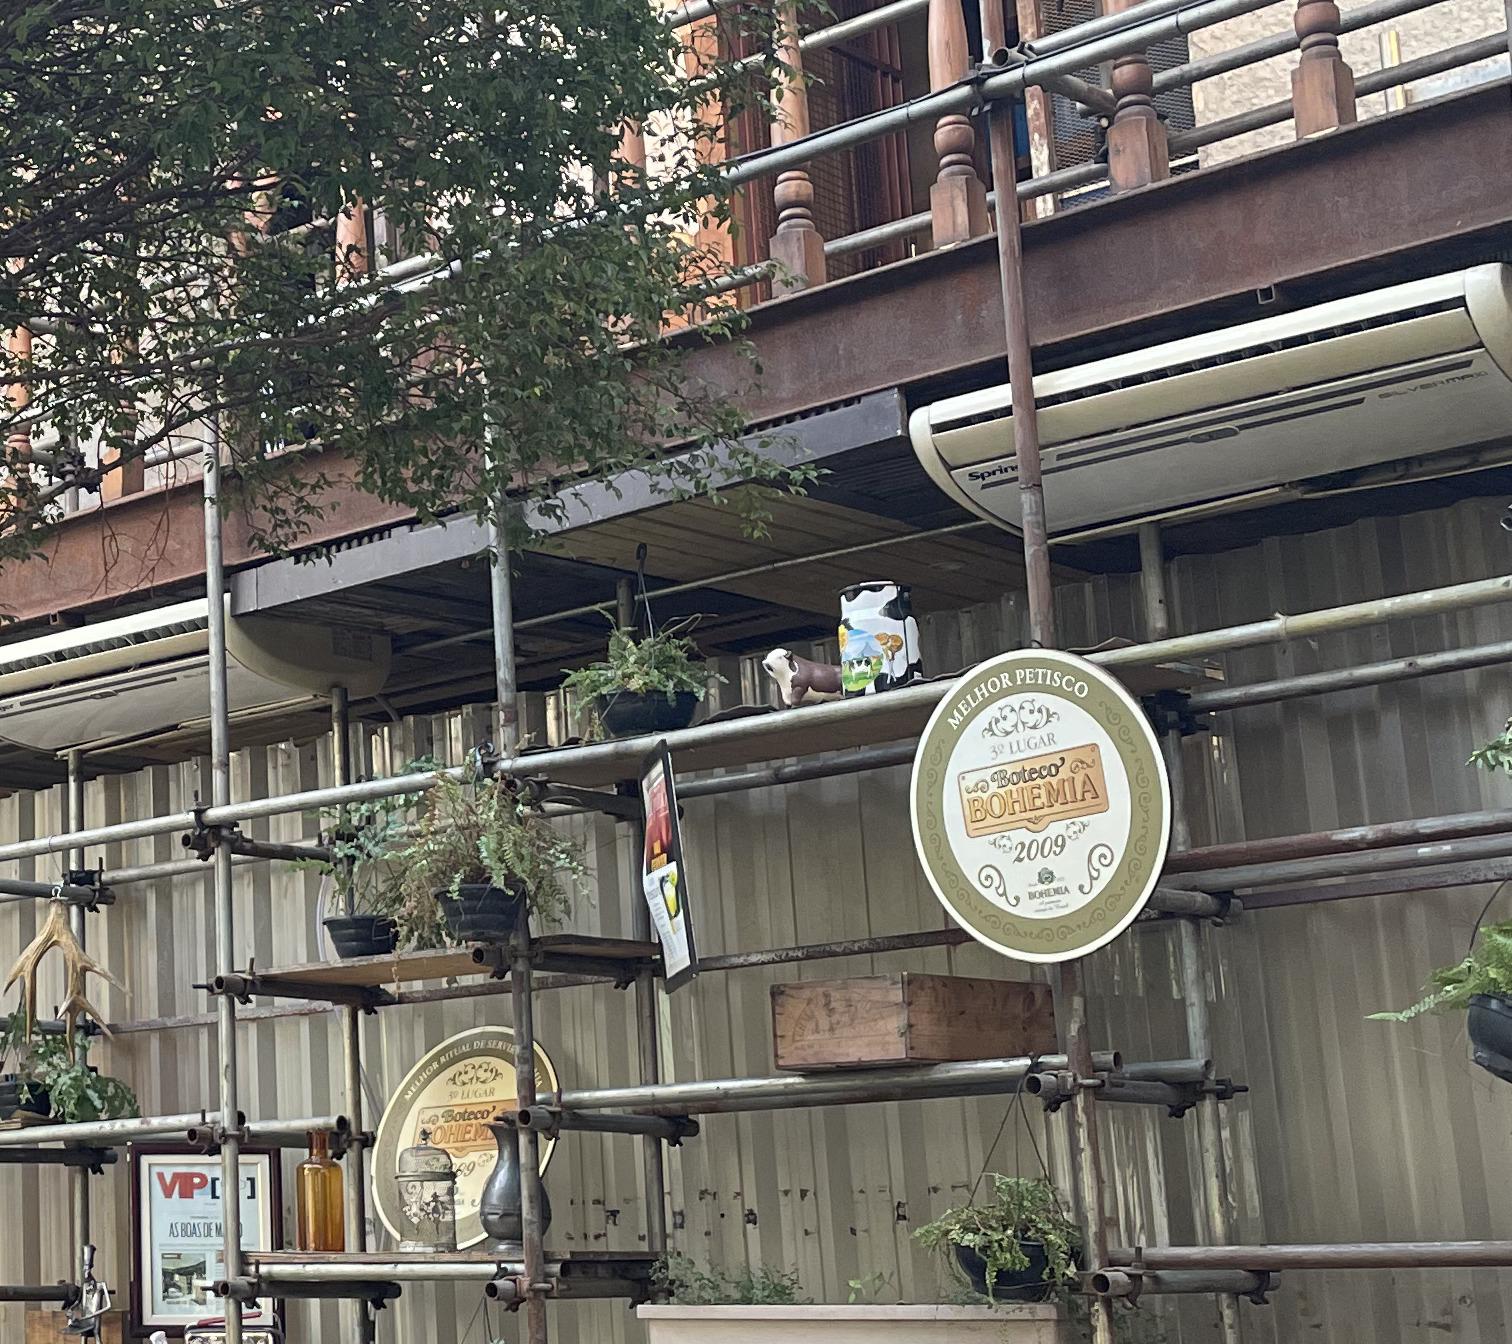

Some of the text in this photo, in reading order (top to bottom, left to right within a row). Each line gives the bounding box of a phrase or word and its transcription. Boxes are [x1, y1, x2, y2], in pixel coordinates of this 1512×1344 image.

[947, 668, 1088, 730] MELHOR PETISCO
[1009, 733, 1058, 755] LUGAR
[990, 757, 1065, 789] Boteco
[967, 773, 1100, 823] BOHEMIA
[1012, 834, 1067, 864] 2009
[404, 1060, 441, 1101] MELHOR
[473, 1040, 486, 1050] DE
[461, 1087, 496, 1100] LUGAR
[441, 1105, 497, 1124] Boteco
[156, 1172, 208, 1199] VIP
[169, 1222, 179, 1237] AS
[181, 1222, 202, 1237] BOAS
[203, 1222, 213, 1237] DE
